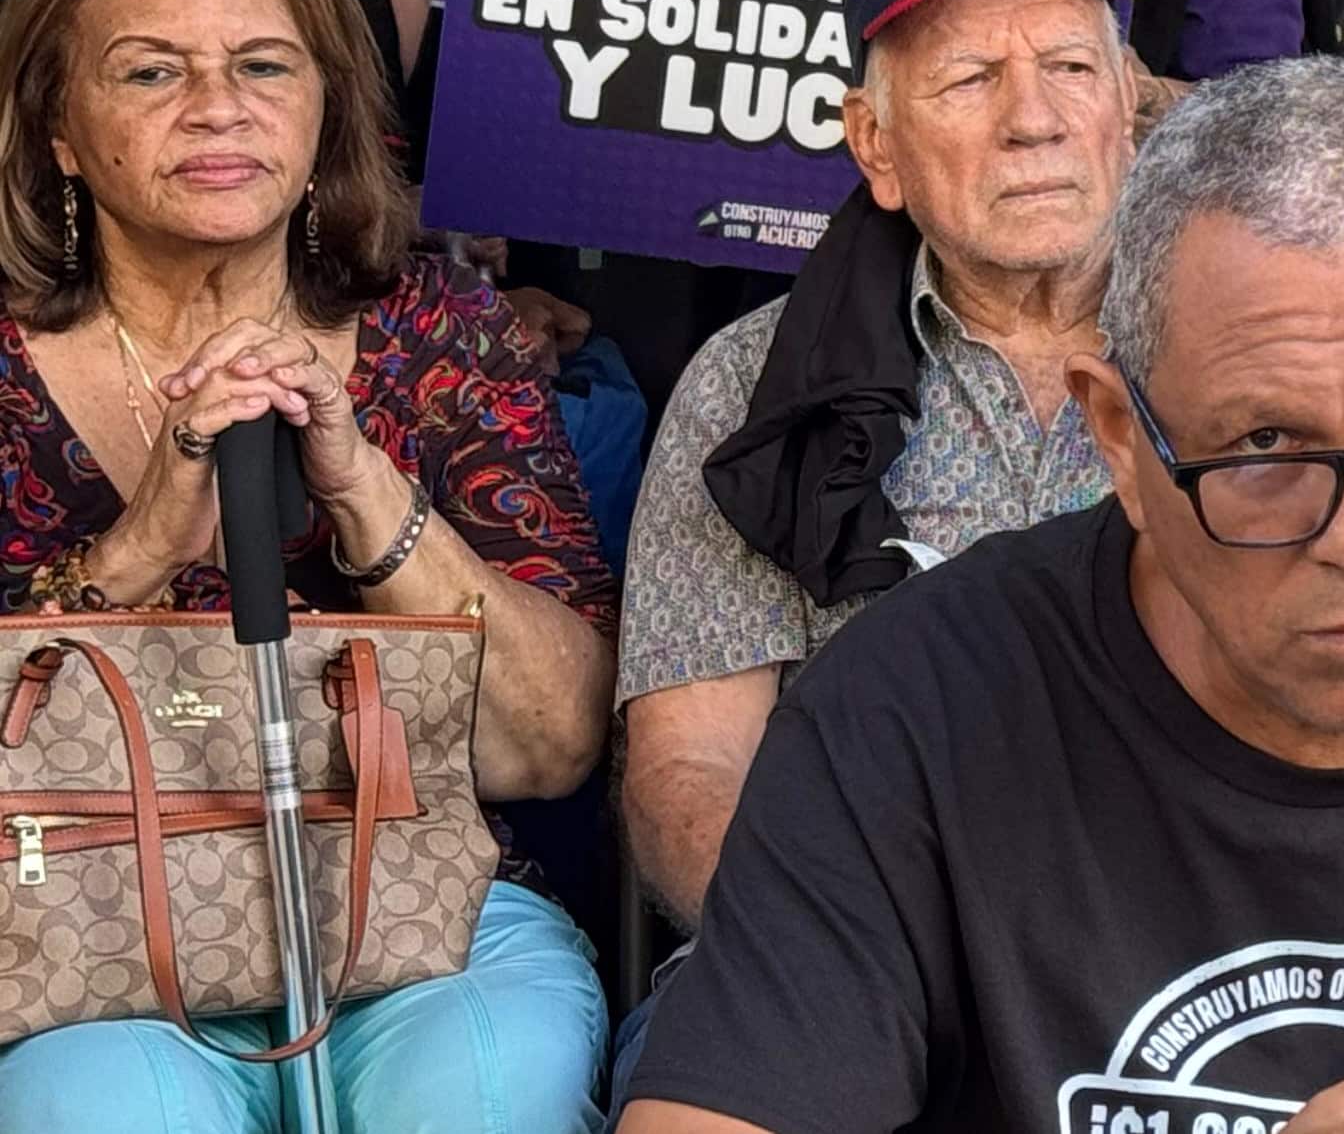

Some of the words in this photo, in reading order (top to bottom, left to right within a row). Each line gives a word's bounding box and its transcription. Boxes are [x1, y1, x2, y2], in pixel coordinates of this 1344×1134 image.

[552, 40, 629, 120] Y
[722, 202, 831, 231] CONSTRUYAMOS
[1141, 967, 1323, 1073] CONSTRUYAMOS
